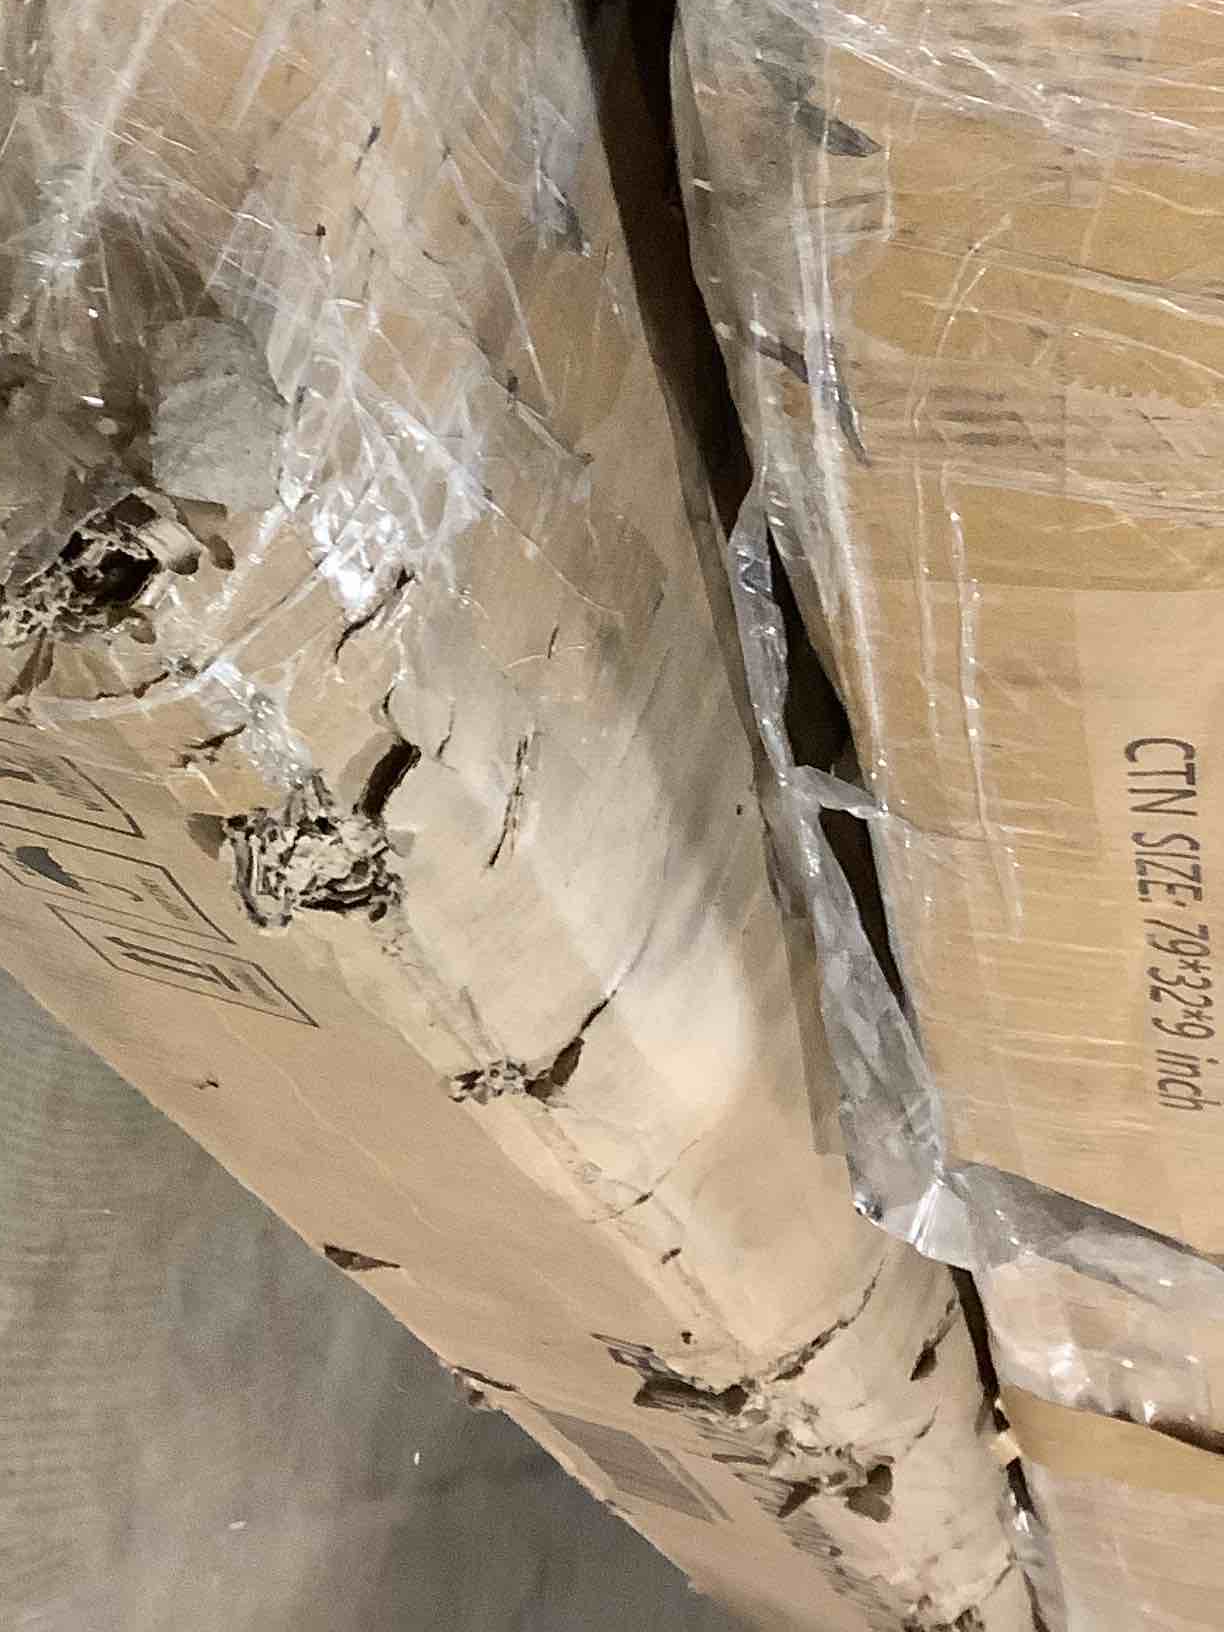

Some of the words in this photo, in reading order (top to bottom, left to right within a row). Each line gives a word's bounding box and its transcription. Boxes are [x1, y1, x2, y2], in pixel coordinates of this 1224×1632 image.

[1124, 737, 1198, 816] CTN
[1131, 831, 1203, 908] SIZE:
[1155, 1048, 1222, 1112] inch
